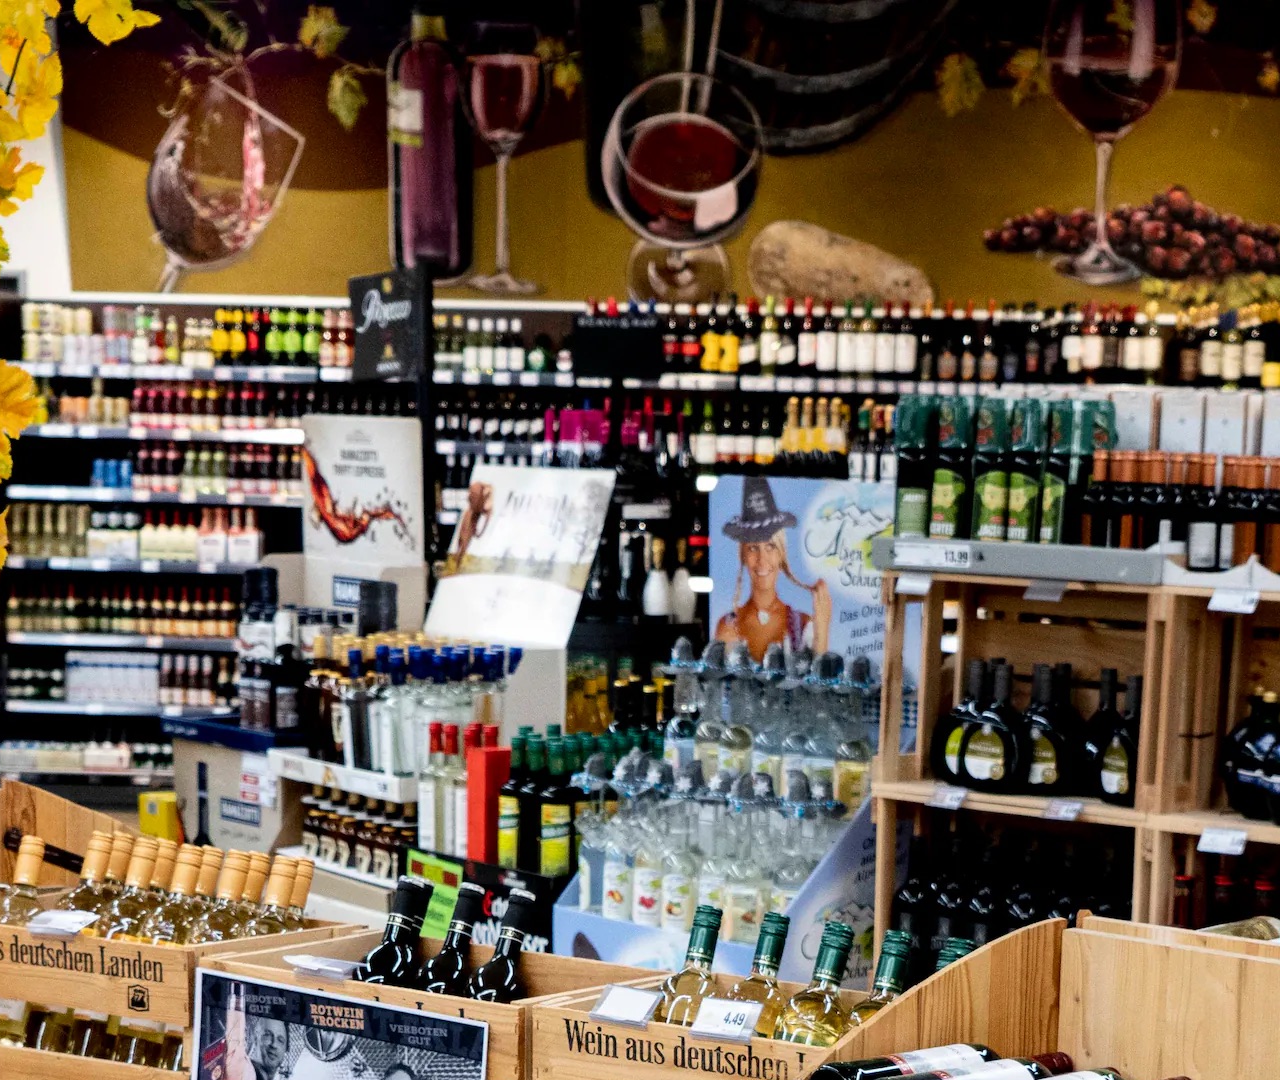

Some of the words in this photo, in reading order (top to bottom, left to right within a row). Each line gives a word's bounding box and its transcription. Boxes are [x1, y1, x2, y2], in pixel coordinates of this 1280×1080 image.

[10, 934, 95, 975] deutschen
[100, 946, 163, 983] Landen
[310, 1004, 365, 1020] ROTWEIN
[723, 1010, 747, 1027] 4.49
[312, 1015, 365, 1031] TROCKEN
[389, 1023, 448, 1039] VERBOTEN
[562, 1018, 619, 1060] Wein
[625, 1036, 665, 1065] aus
